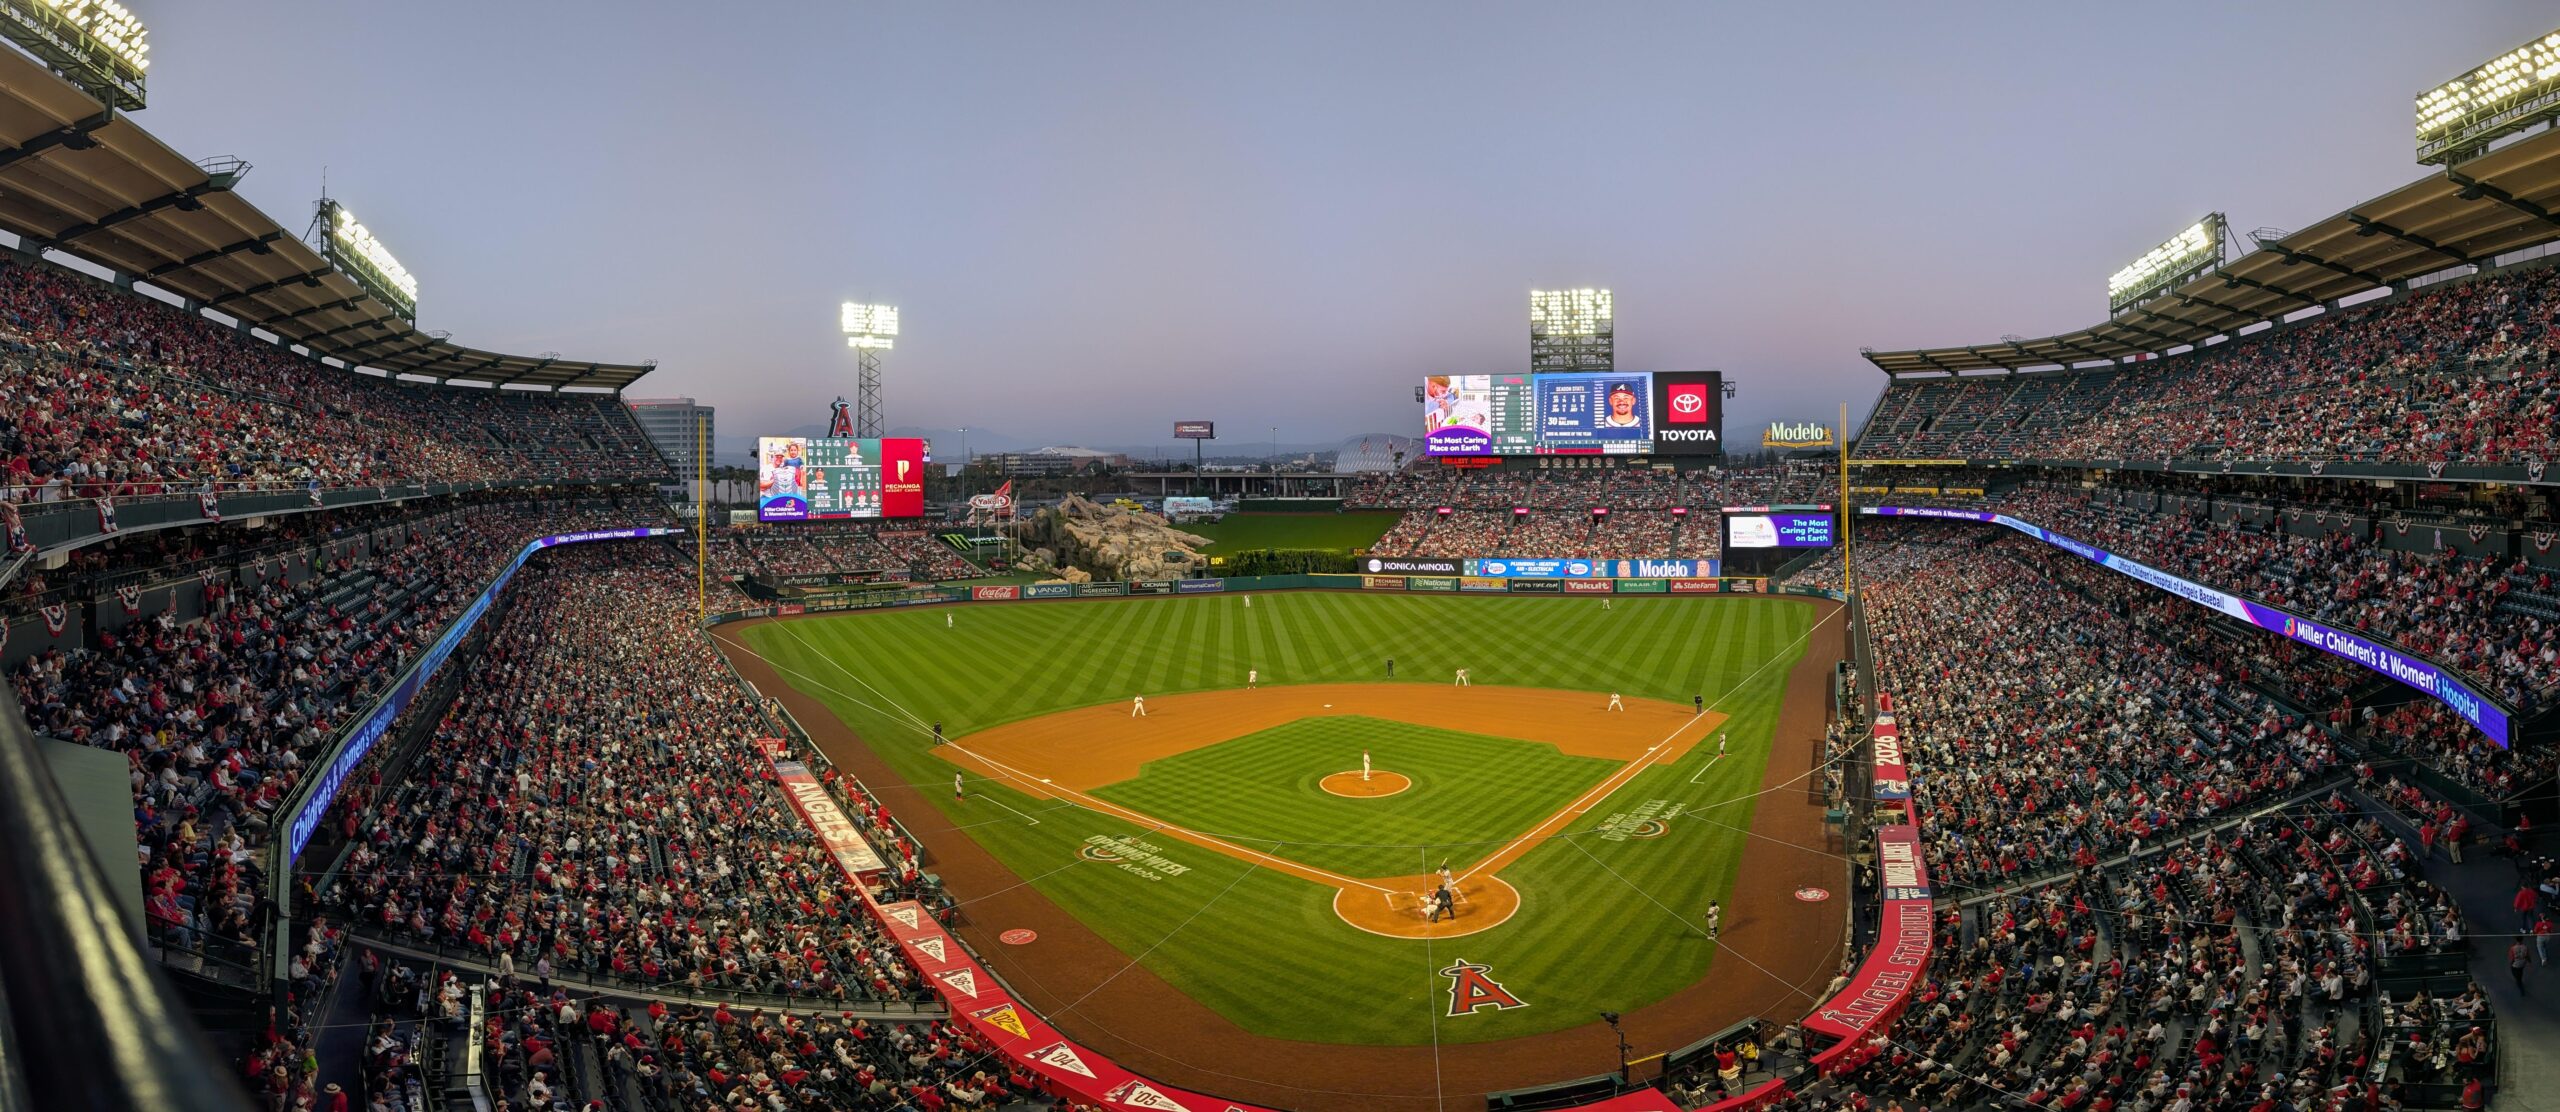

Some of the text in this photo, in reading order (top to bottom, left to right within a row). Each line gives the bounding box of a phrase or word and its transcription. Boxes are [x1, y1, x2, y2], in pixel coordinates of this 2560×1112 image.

[1660, 430, 1716, 441] TOYOTA
[1771, 422, 1824, 441] Modelo
[1463, 437, 1488, 445] Caring
[613, 530, 635, 538] Hospital
[1780, 527, 1805, 535] Caring
[1807, 534, 1828, 542] Earth
[1384, 562, 1455, 571] KONICA MINOLTA
[1639, 560, 1688, 577] Modelo
[1423, 578, 1452, 587] National
[2118, 559, 2225, 609] Official Children's Hospital of Angels Baseball
[2297, 621, 2480, 724] Miller Children's & Women's Hospital
[1874, 735, 1901, 767] 2026
[292, 697, 396, 855] Children's & Women's Hospital
[788, 782, 858, 843] ANGELS
[1084, 834, 1192, 877] OPENING WEEK
[1117, 863, 1163, 882] Adobe
[1820, 904, 1930, 1031] ANGEL STADIUM
[1439, 957, 1531, 1017] A
[992, 1012, 1016, 1026] '02
[1050, 1052, 1075, 1067] '04
[1134, 1091, 1162, 1106] '05
